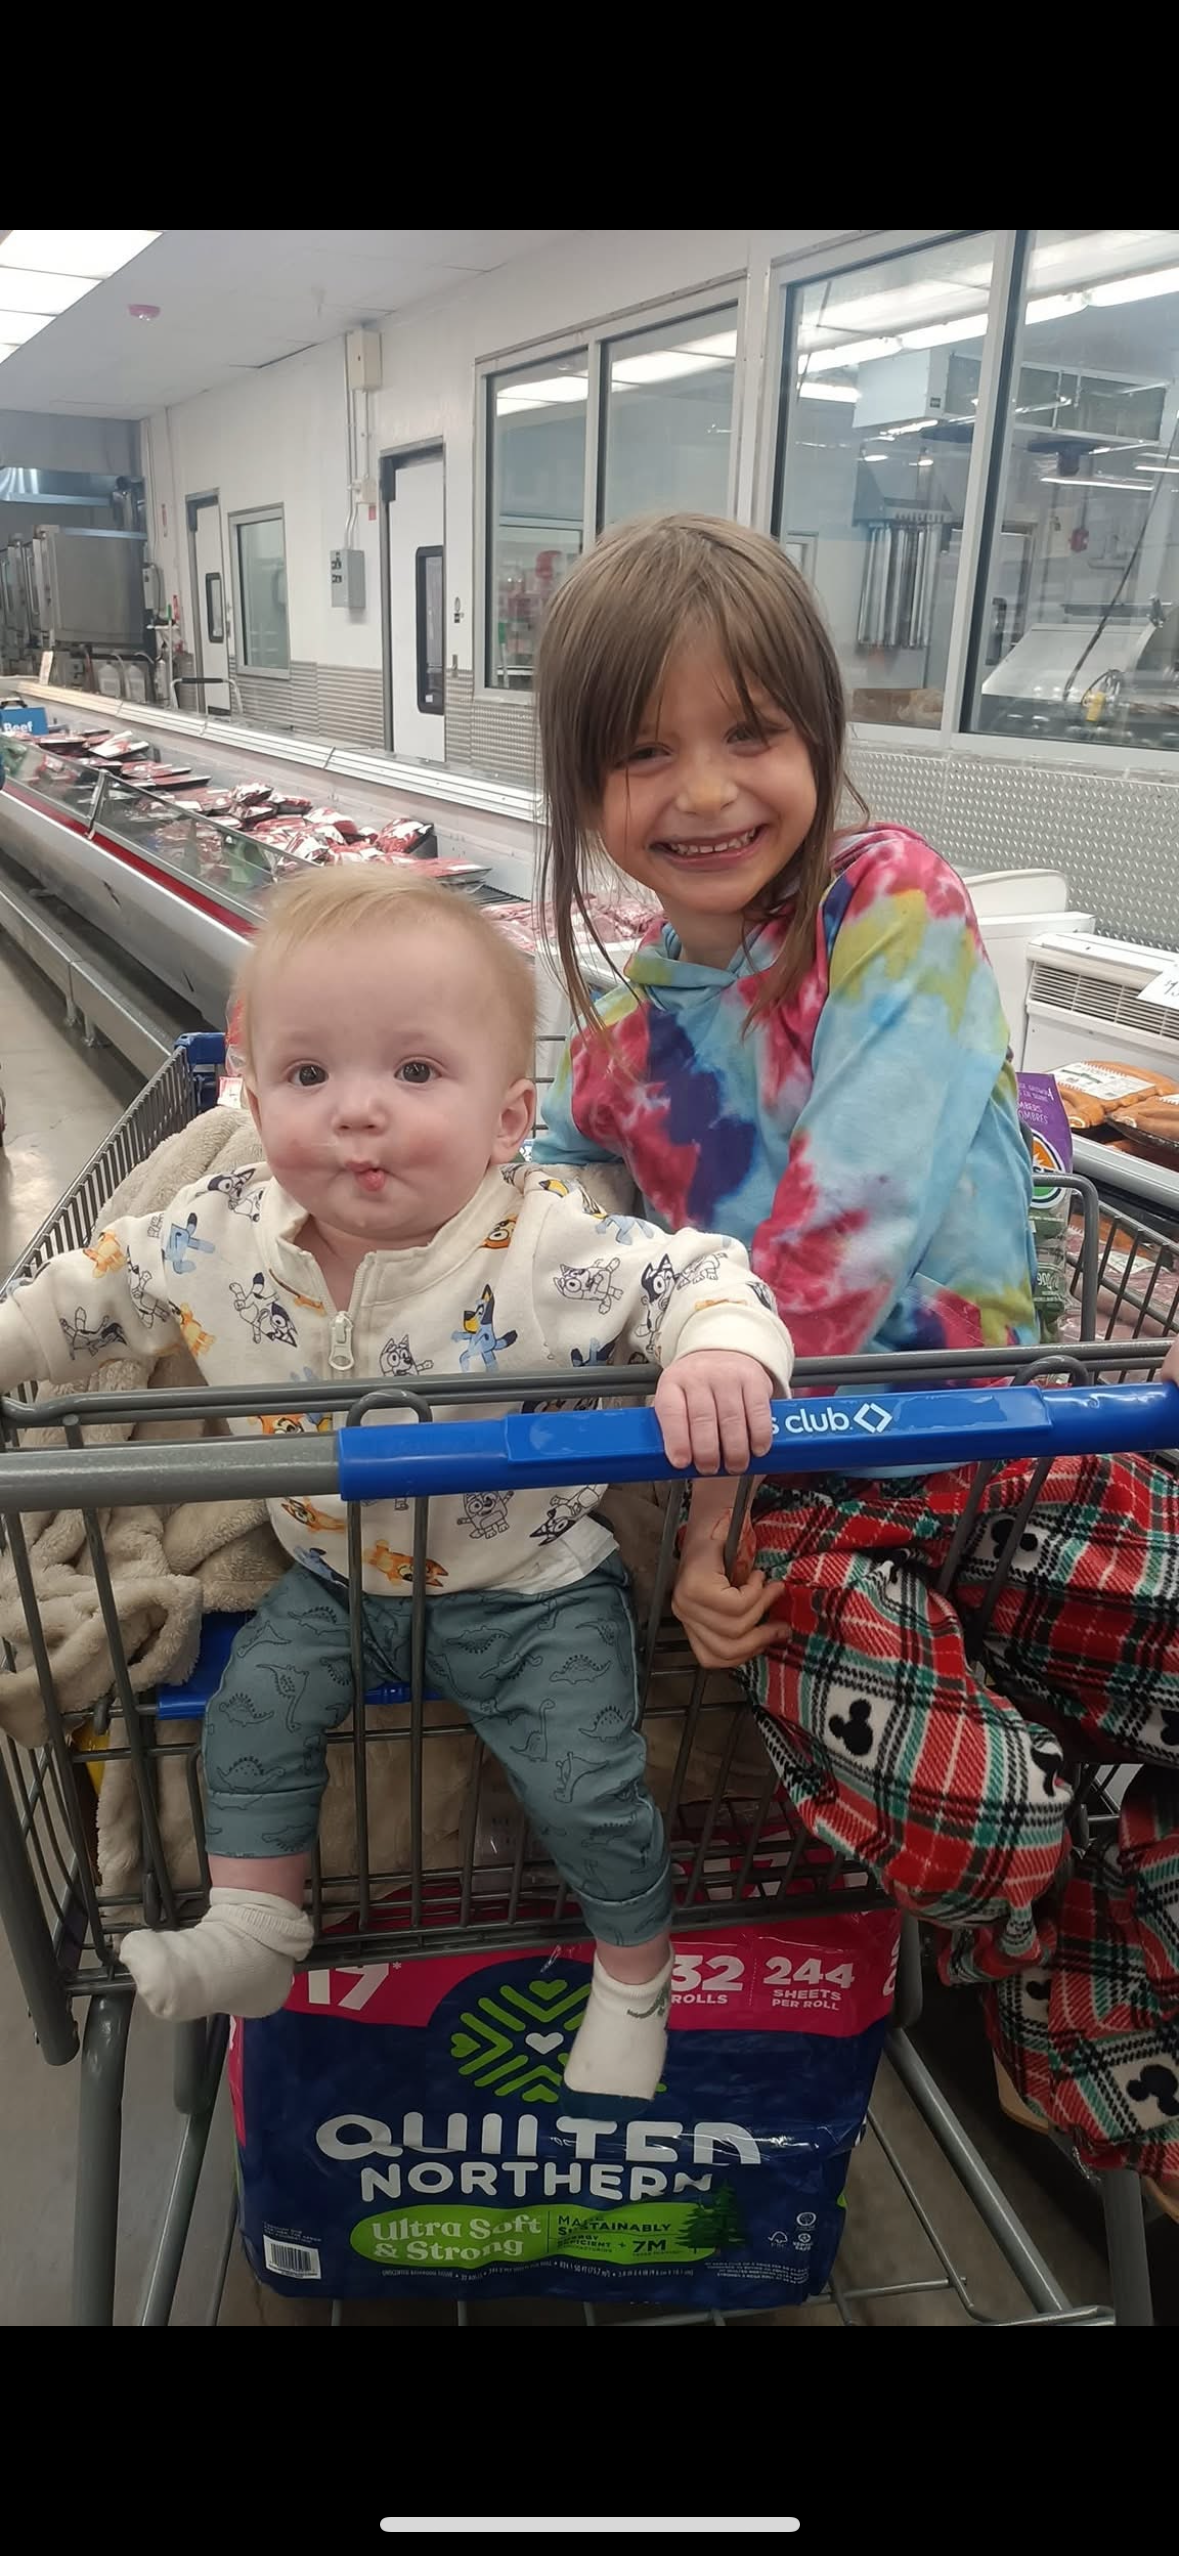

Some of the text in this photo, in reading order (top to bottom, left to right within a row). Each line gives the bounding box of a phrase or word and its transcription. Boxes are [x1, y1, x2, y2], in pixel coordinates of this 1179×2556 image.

[4, 721, 33, 732] Beef
[785, 1407, 849, 1434] club
[670, 1954, 745, 1992] 32
[763, 1955, 856, 1989] 244
[671, 1993, 729, 2004] ROLLS
[773, 1988, 842, 2001] SHEETS
[772, 1998, 840, 2011] PER ROLL
[360, 2161, 713, 2202] NORTHERN
[372, 2213, 542, 2241] Ultra Soft
[558, 2221, 671, 2236] STAINABLY
[374, 2238, 524, 2262] & Strong
[632, 2239, 666, 2252] 7M
